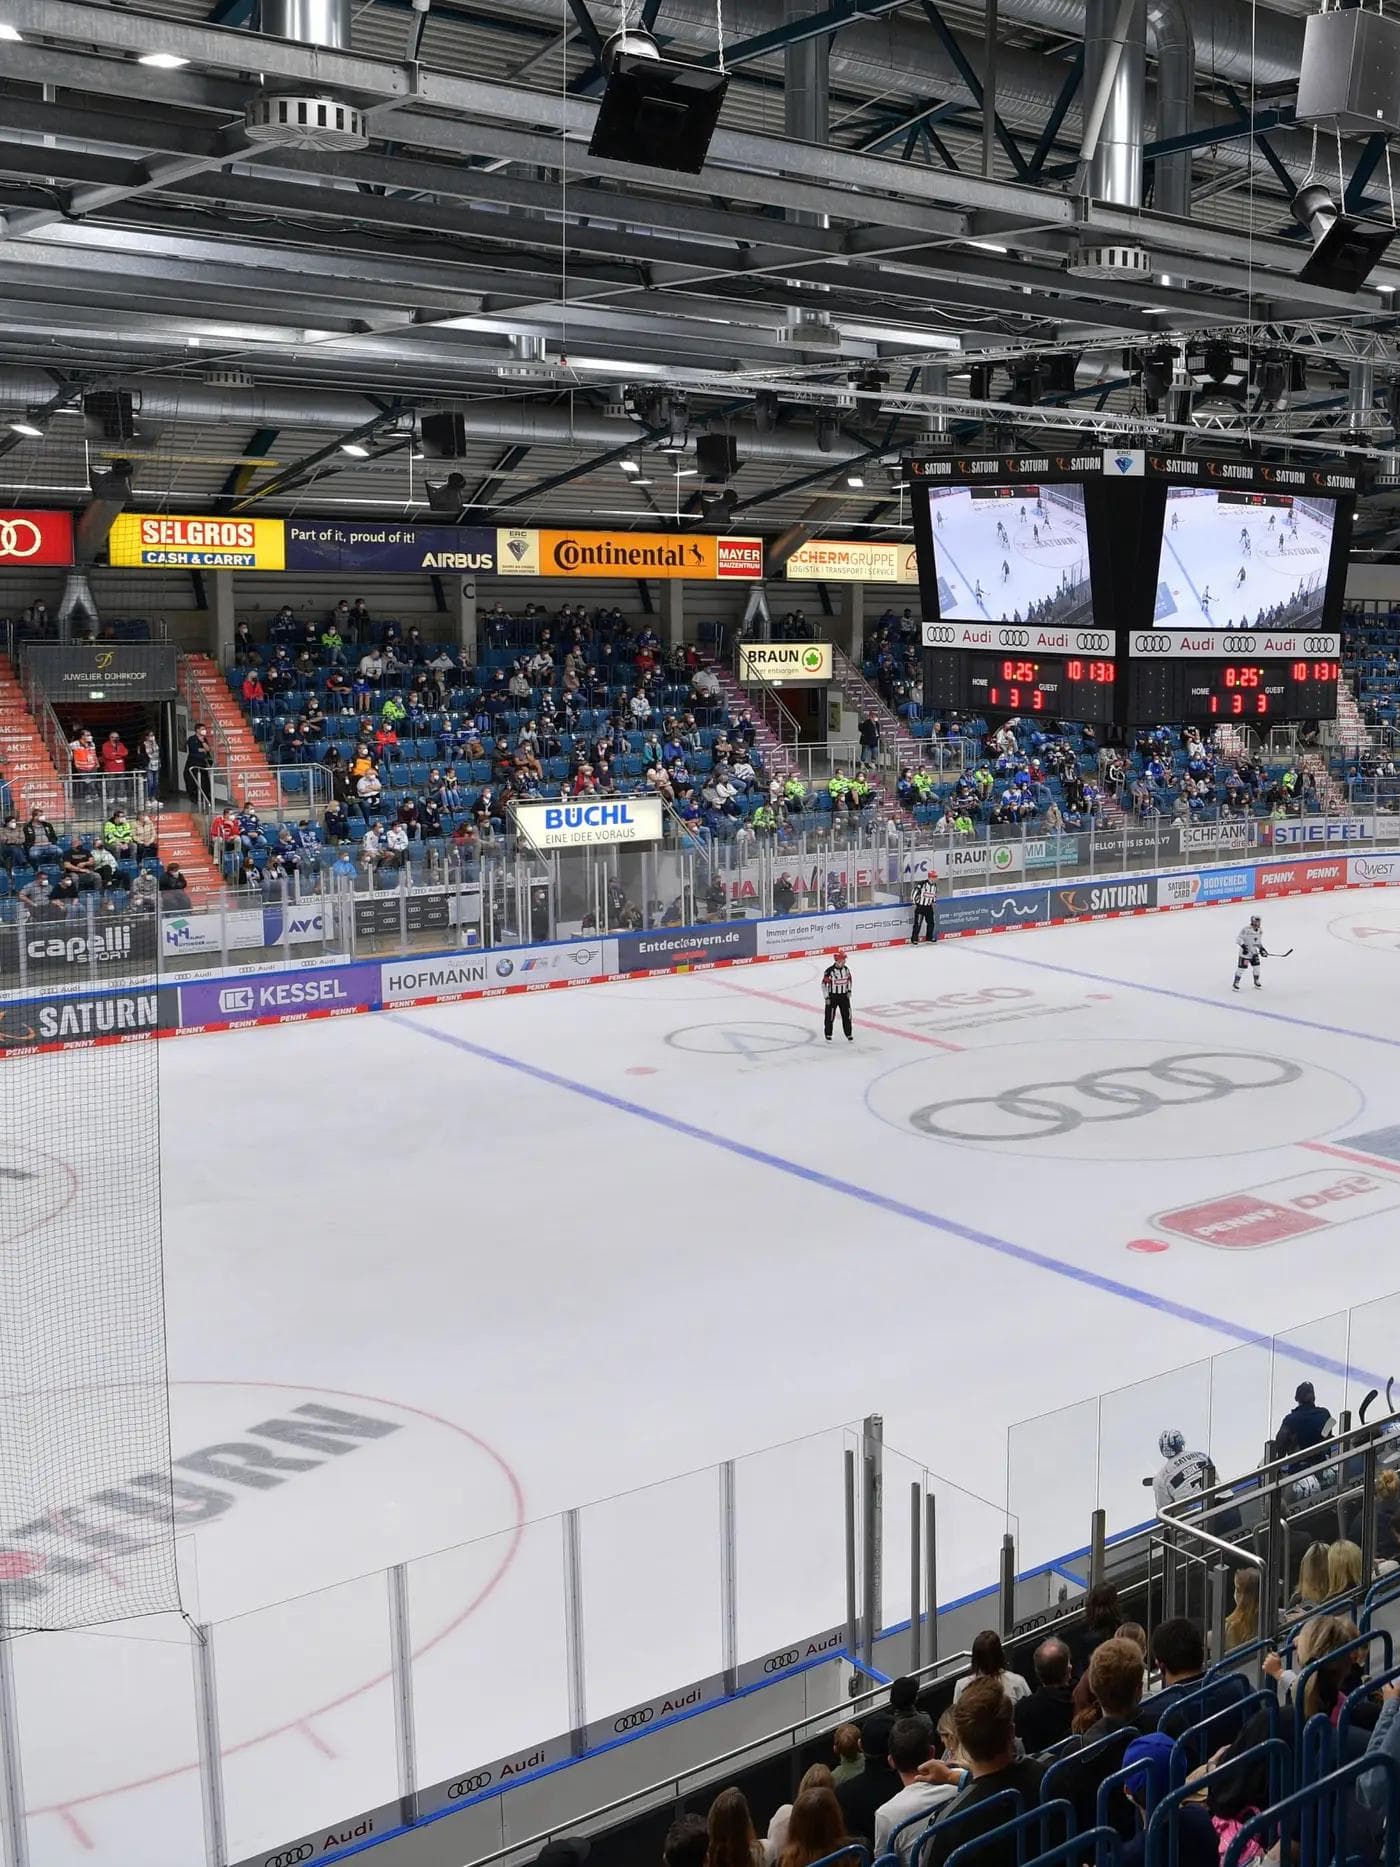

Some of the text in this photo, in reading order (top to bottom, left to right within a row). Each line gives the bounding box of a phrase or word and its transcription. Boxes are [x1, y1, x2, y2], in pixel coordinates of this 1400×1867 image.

[925, 463, 951, 475] SATURN
[972, 461, 998, 474] SATURN
[1020, 459, 1048, 472] SATURN
[1071, 457, 1100, 470] SATURN
[1166, 459, 1199, 474] SATURN
[1222, 465, 1253, 479] SATURN
[1276, 470, 1305, 484] SATURN
[1327, 475, 1356, 488] SATURN
[142, 519, 254, 547] SELGROS
[291, 528, 415, 546] Part of it, proud of it!
[146, 552, 253, 567] CASH & CARRY
[421, 552, 493, 570] AIRBUS
[554, 539, 686, 571] Continental
[719, 548, 760, 561] MAYER
[719, 561, 761, 569] BAUZENTRUM
[789, 566, 820, 574] LOGISTIK
[868, 567, 895, 576] SERVICE
[962, 630, 992, 643] Audi
[1037, 634, 1069, 647] Audi
[1180, 637, 1215, 651] Audi
[1264, 638, 1297, 651] Audi
[749, 650, 799, 663] BRAUN
[63, 672, 101, 681] JUWELIER
[1067, 661, 1082, 680] 10
[1293, 663, 1307, 681] 10
[972, 678, 989, 687] HOME
[1038, 683, 1059, 692] GUEST
[1191, 687, 1210, 695] HOME
[1264, 686, 1286, 694] GUEST
[1010, 688, 1043, 710] 3 3
[1233, 695, 1242, 713] 3
[1257, 694, 1267, 713] 3
[546, 804, 634, 829] BÜCHL
[546, 828, 636, 844] EINE IDEE VORAUS
[1275, 824, 1374, 844] STIEFEL
[1262, 871, 1295, 886] PENNY.
[1306, 866, 1340, 881] PENNY.
[1168, 879, 1191, 891] SATURN
[1203, 873, 1248, 889] BODYCHECK
[1091, 884, 1148, 911] SATURN
[1173, 889, 1191, 899] CARD
[288, 915, 324, 934] AVC
[766, 922, 840, 938] Immer in den Play-offs
[27, 925, 131, 963] capelli
[77, 950, 131, 963] SPORT
[258, 963, 277, 973] Audi
[194, 970, 213, 980] Audi
[389, 966, 484, 992] HOFMANN
[260, 979, 347, 1007] KESSEL
[526, 983, 551, 992] PENNY.
[390, 1000, 417, 1008] PENNY.
[437, 993, 464, 1002] PENNY.
[39, 995, 158, 1038] SATURN
[330, 1006, 359, 1016] PENNY.
[229, 1018, 260, 1029] PENNY.
[279, 1012, 310, 1024] PENNY.
[175, 1025, 208, 1036] PENNY.
[63, 1039, 96, 1050] PENNY.
[806, 1633, 843, 1657] Audi
[661, 1690, 702, 1715] Audi
[500, 1751, 546, 1779] Audi
[323, 1818, 374, 1851] Audi
